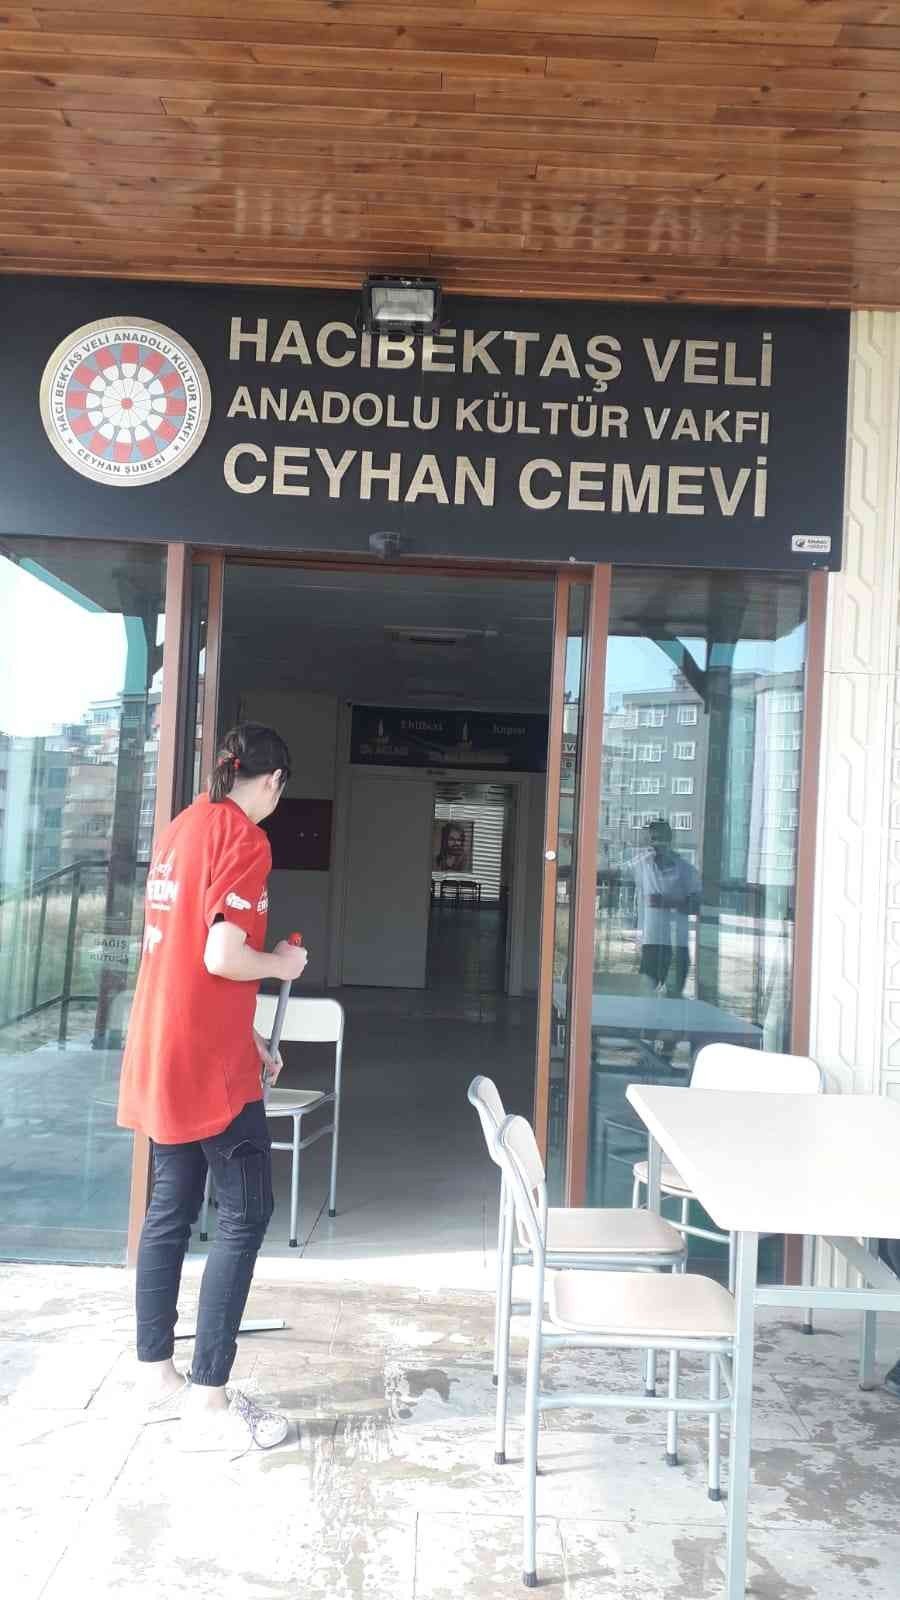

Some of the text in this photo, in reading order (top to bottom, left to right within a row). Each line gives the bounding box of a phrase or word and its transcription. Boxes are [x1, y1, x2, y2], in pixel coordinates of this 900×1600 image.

[114, 332, 171, 354] ANADOLU
[229, 316, 774, 393] HACIBEKTAŞ VELİ
[226, 385, 770, 445] ANADOLU KÜLTÜR VAKFI
[77, 448, 121, 473] CEYHAN
[223, 442, 768, 518] CEYHAN CEMEVİ
